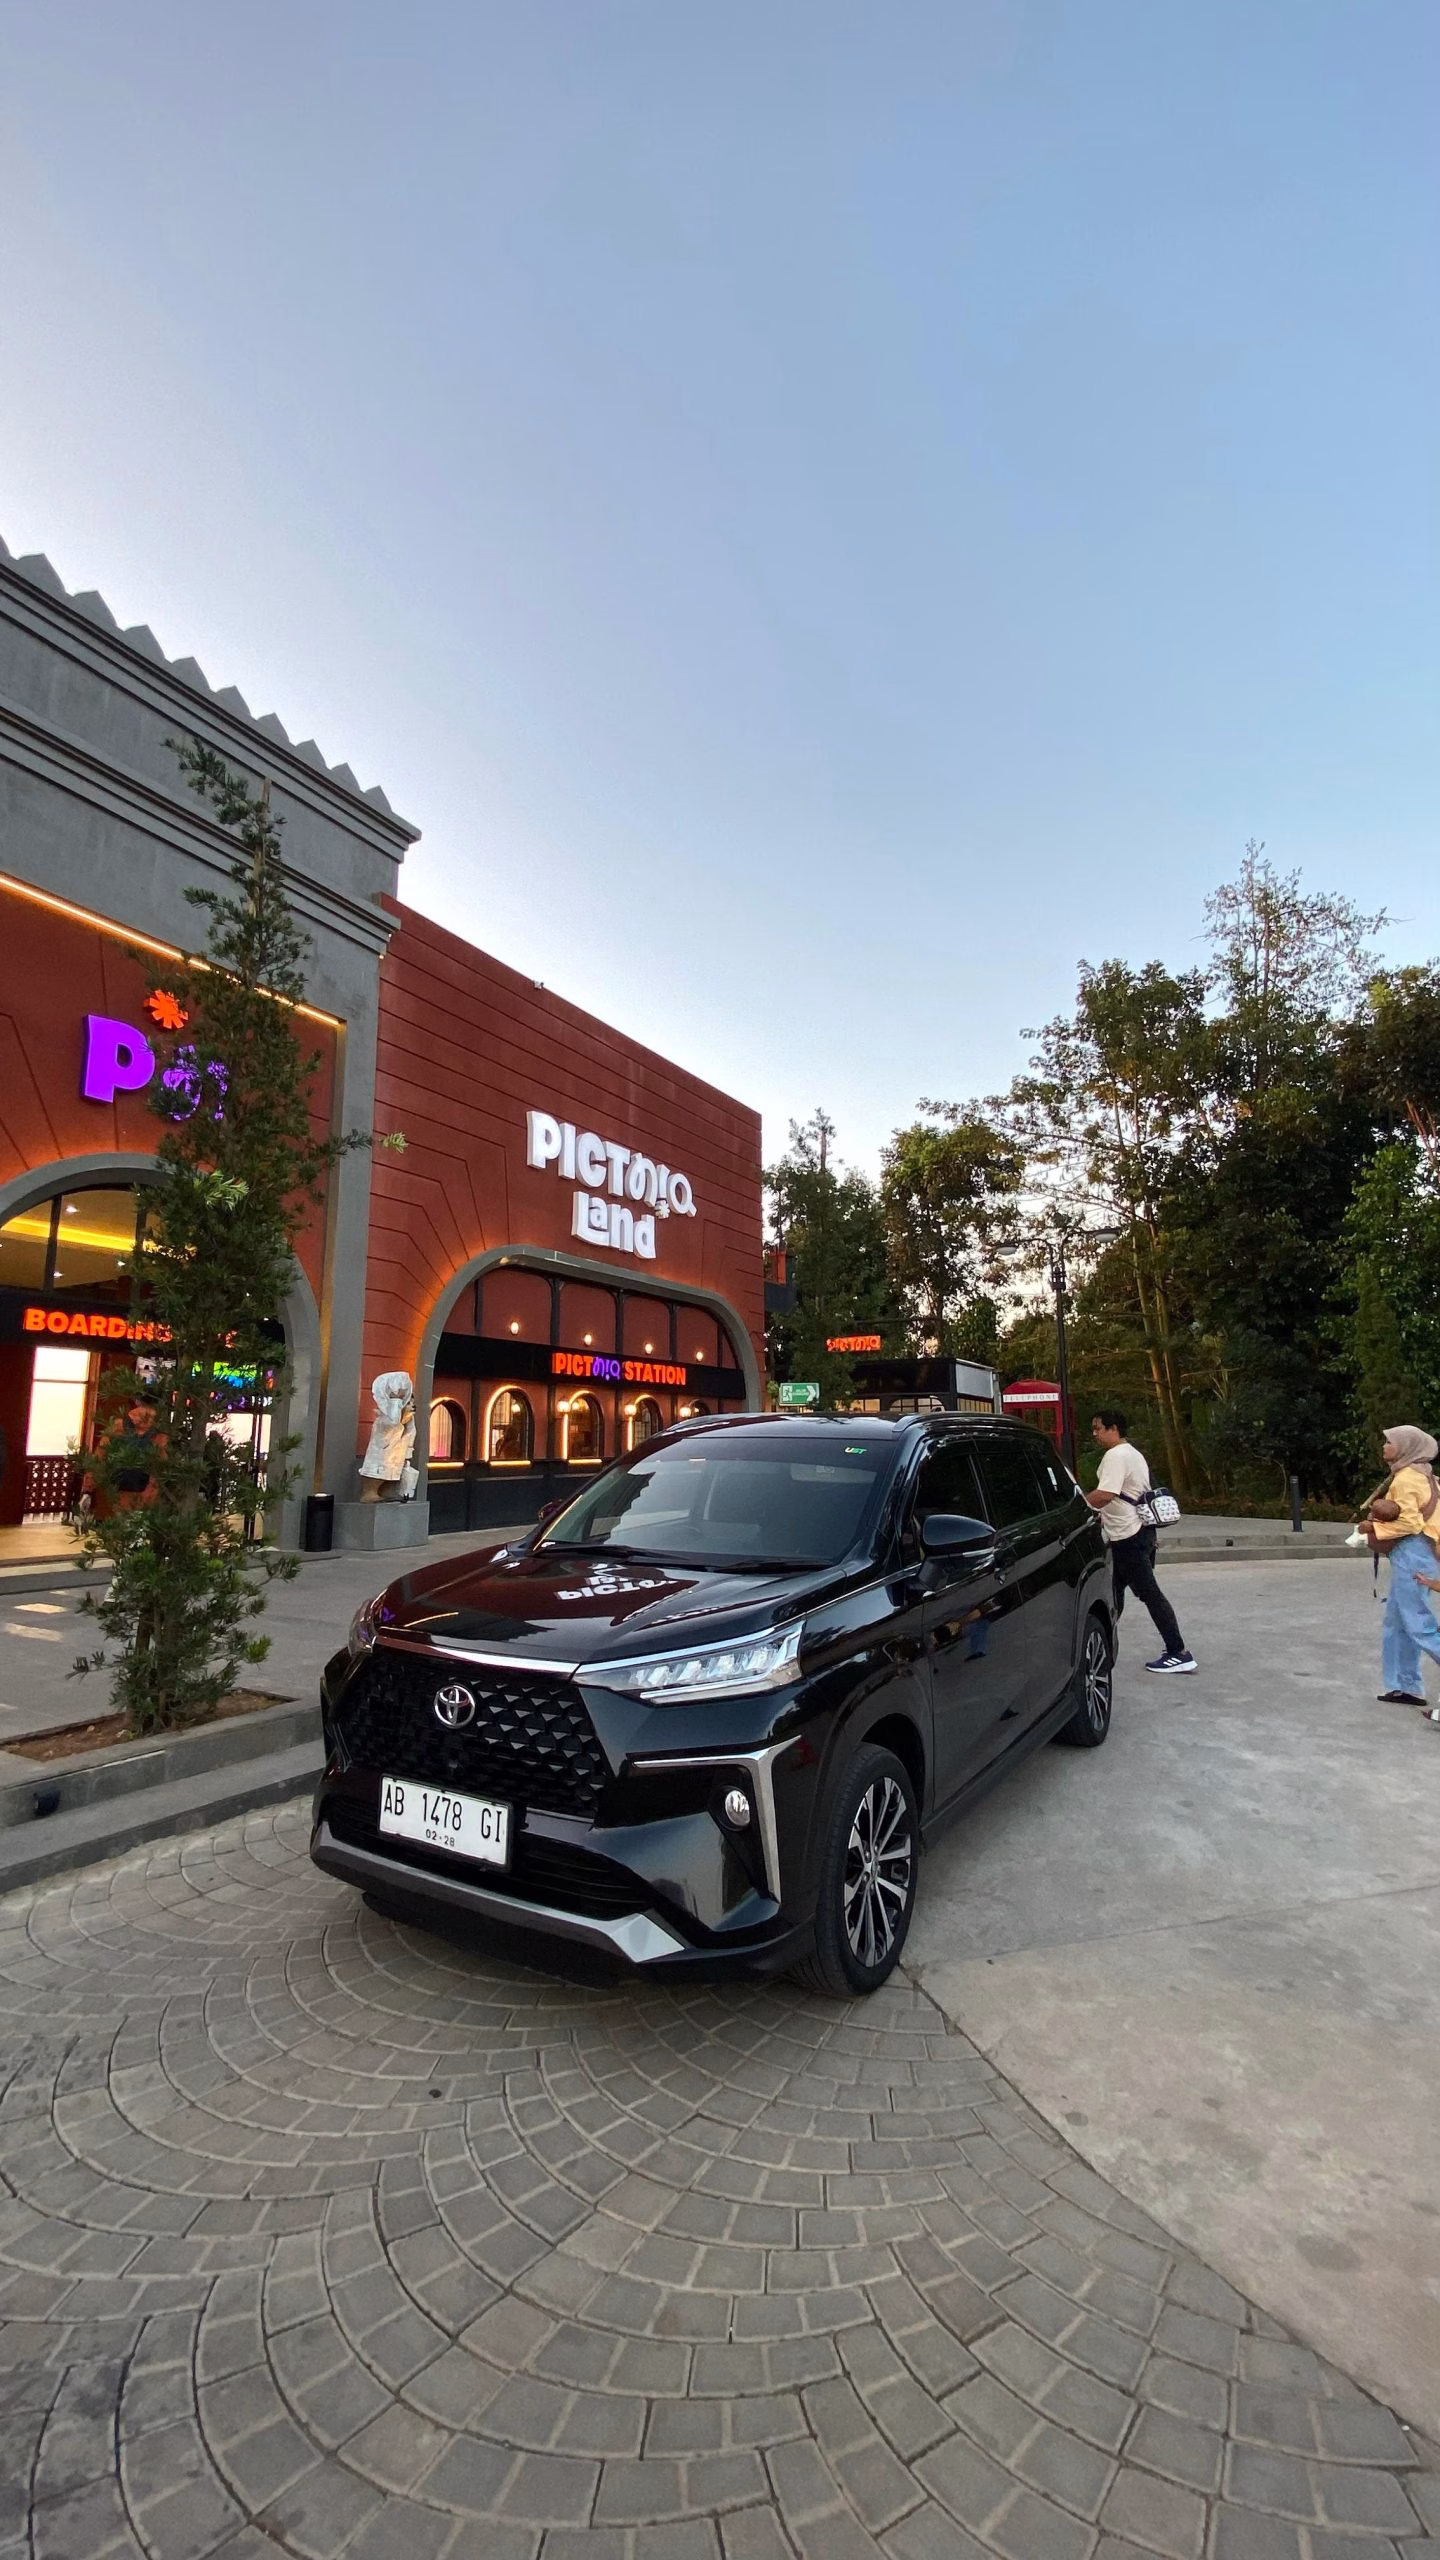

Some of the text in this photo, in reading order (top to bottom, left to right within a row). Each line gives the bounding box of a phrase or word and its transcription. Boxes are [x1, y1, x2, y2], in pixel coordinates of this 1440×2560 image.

[571, 1191, 656, 1259] Land
[624, 1361, 686, 1386] STATION
[1004, 1394, 1058, 1402] TELEPHONE
[384, 1784, 503, 1843] AB 1478 GI
